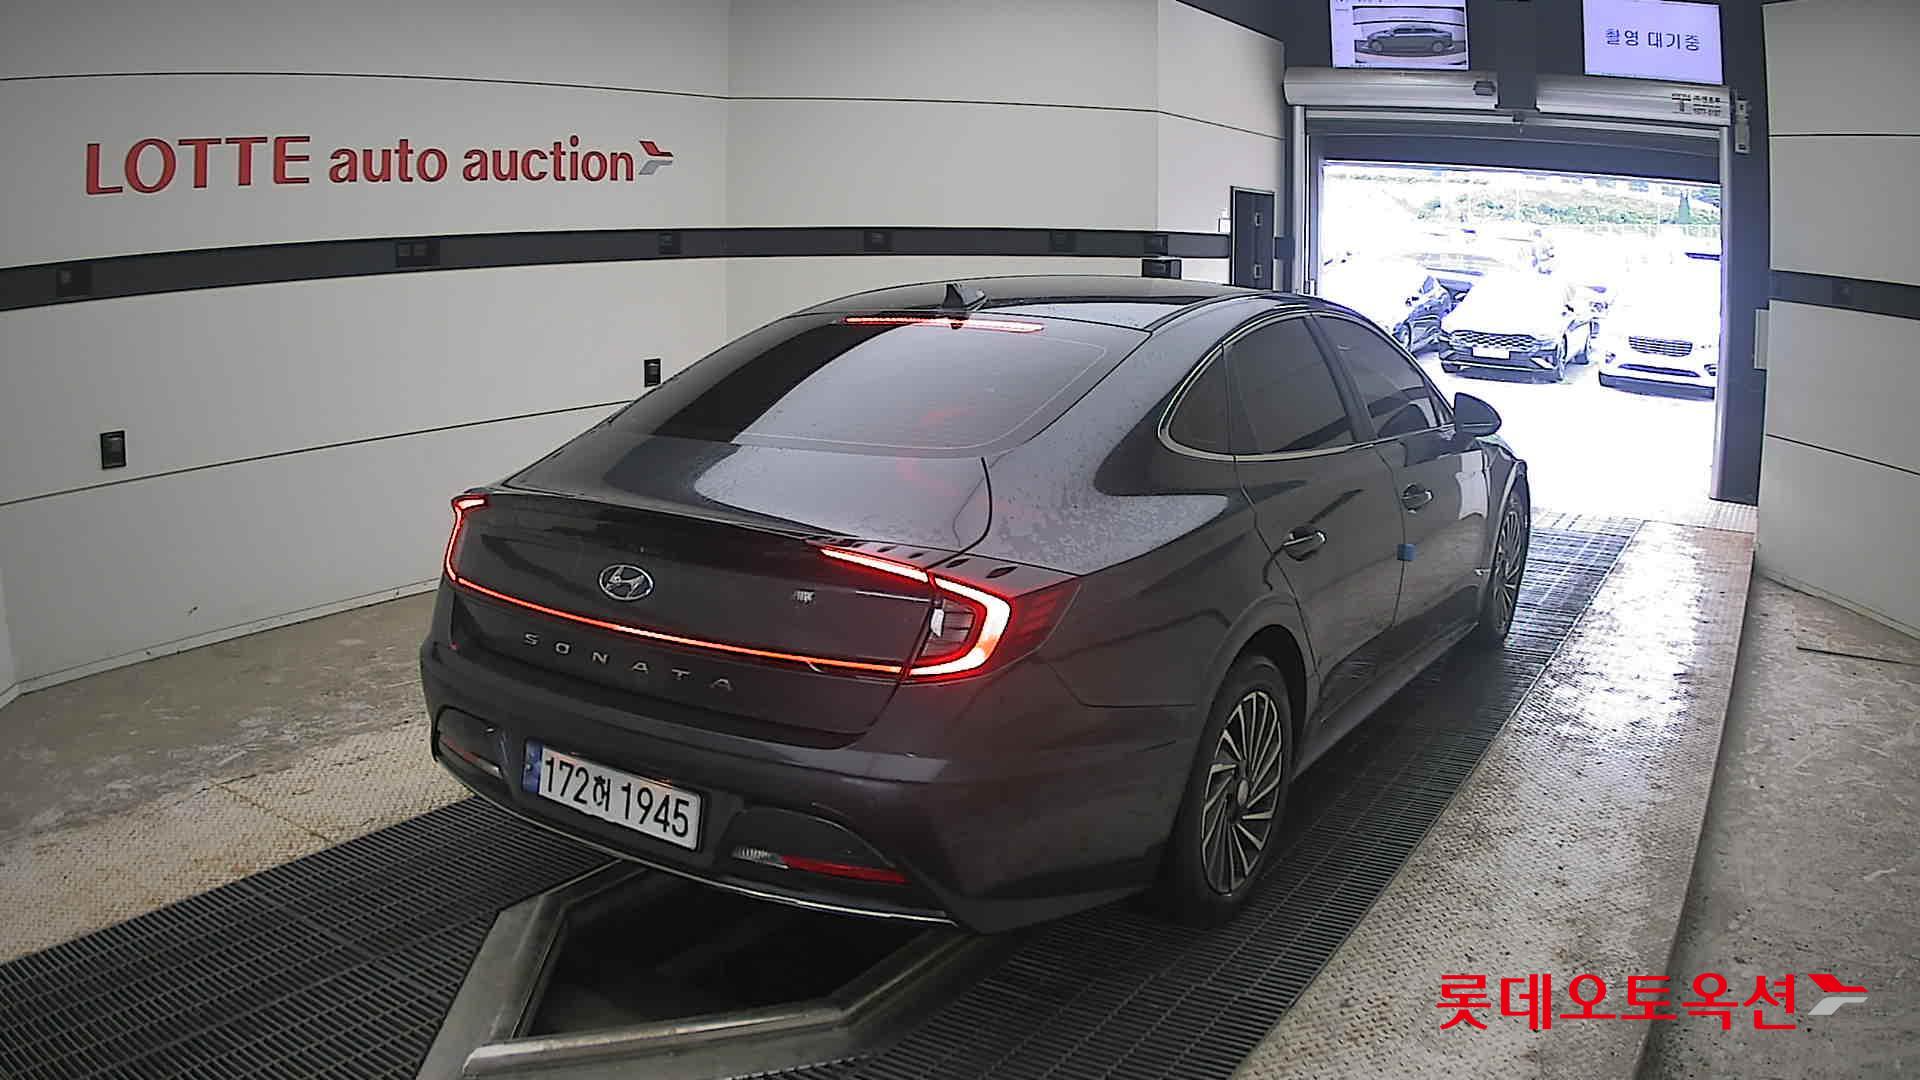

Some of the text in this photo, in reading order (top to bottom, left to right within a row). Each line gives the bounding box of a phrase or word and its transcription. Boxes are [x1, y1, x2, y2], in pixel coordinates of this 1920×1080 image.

[1648, 32, 1700, 51] 대기중
[86, 135, 635, 195] LOTTE auto auction
[523, 633, 733, 691] SONATA
[545, 757, 690, 838] 172허 1945
